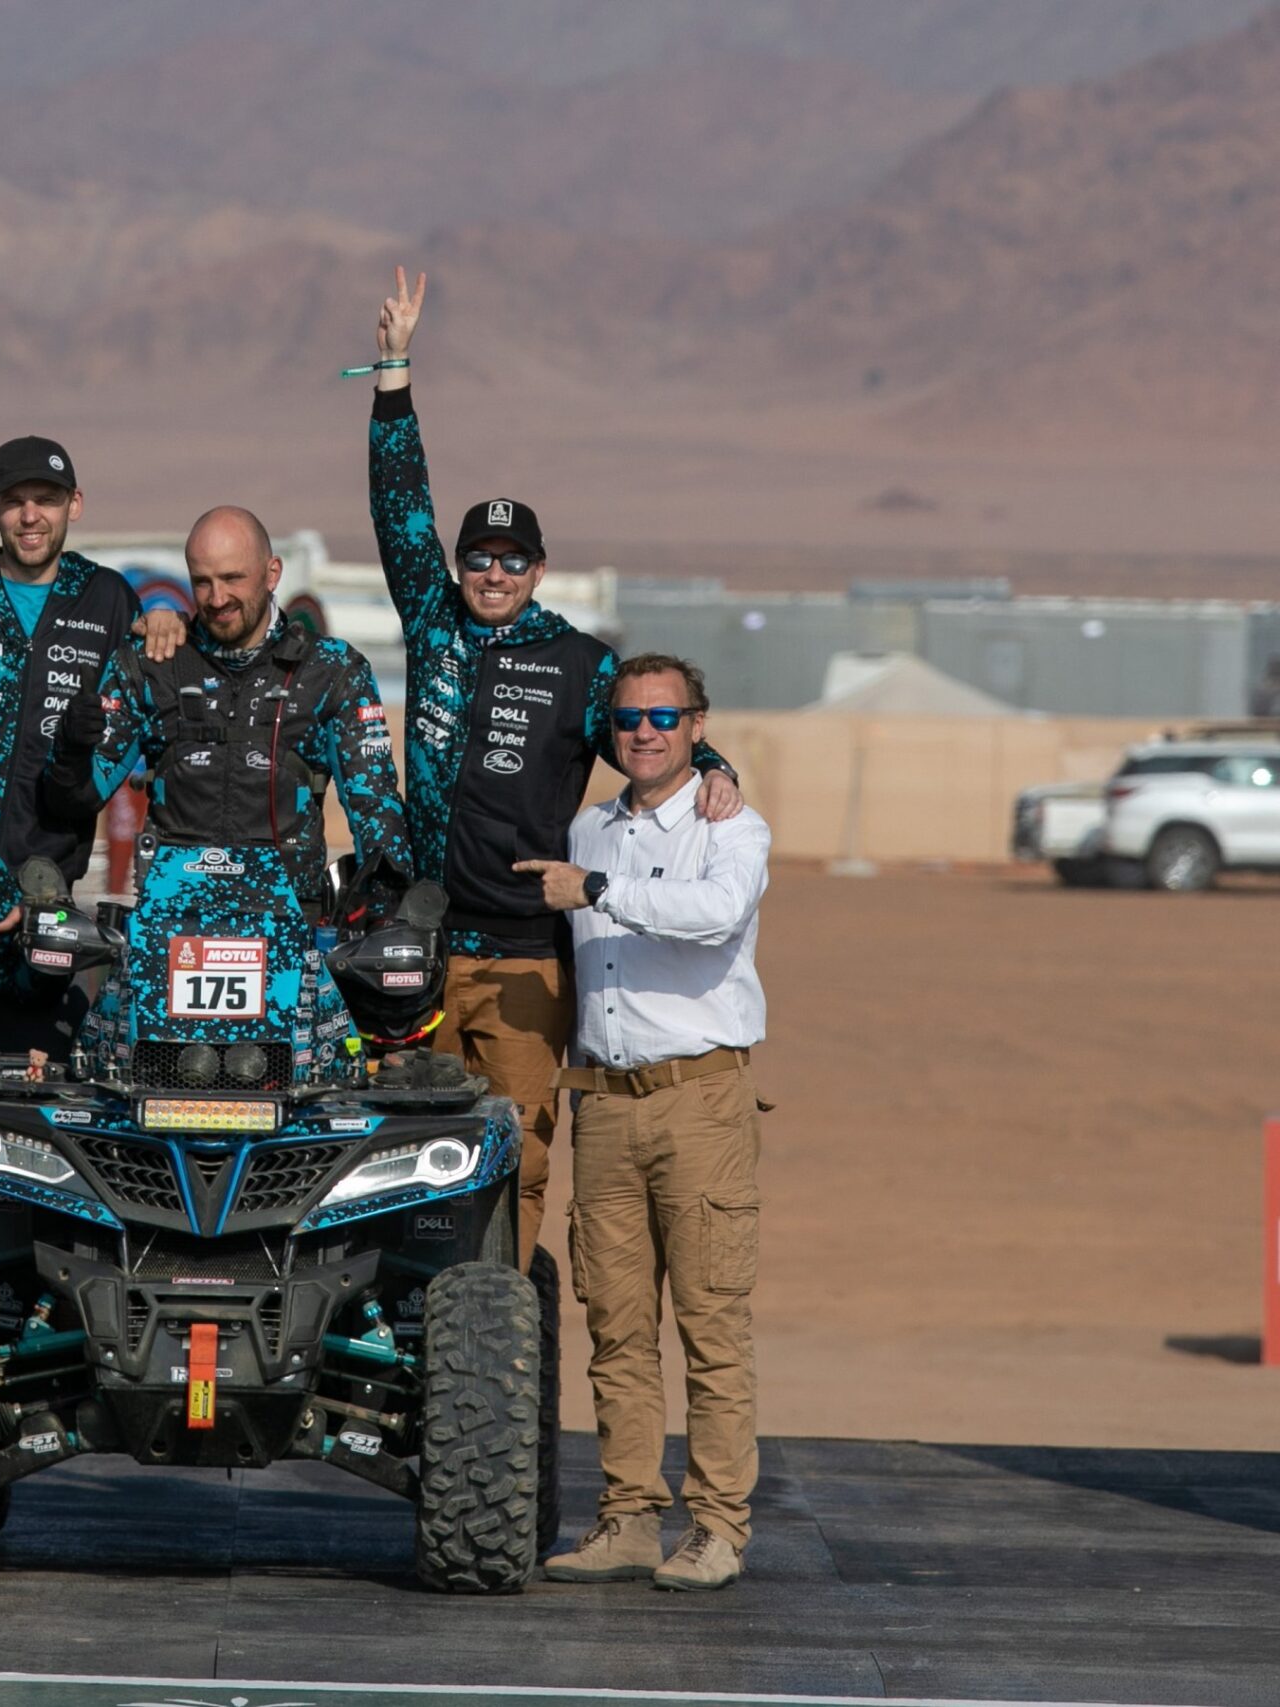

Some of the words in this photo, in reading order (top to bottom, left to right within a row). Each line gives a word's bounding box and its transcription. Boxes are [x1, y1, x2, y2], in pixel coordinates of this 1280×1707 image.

[47, 671, 81, 688] DELL
[525, 688, 553, 698] HANSA
[523, 695, 552, 706] SERVICE
[491, 706, 530, 723] DELL
[488, 731, 526, 747] OlyBet
[186, 863, 242, 872] CFMOTO
[34, 952, 68, 964] MOTUL
[207, 949, 258, 961] MOTUL
[386, 974, 420, 984] MOTUL
[186, 976, 247, 1010] 175
[418, 1218, 452, 1229] DELL
